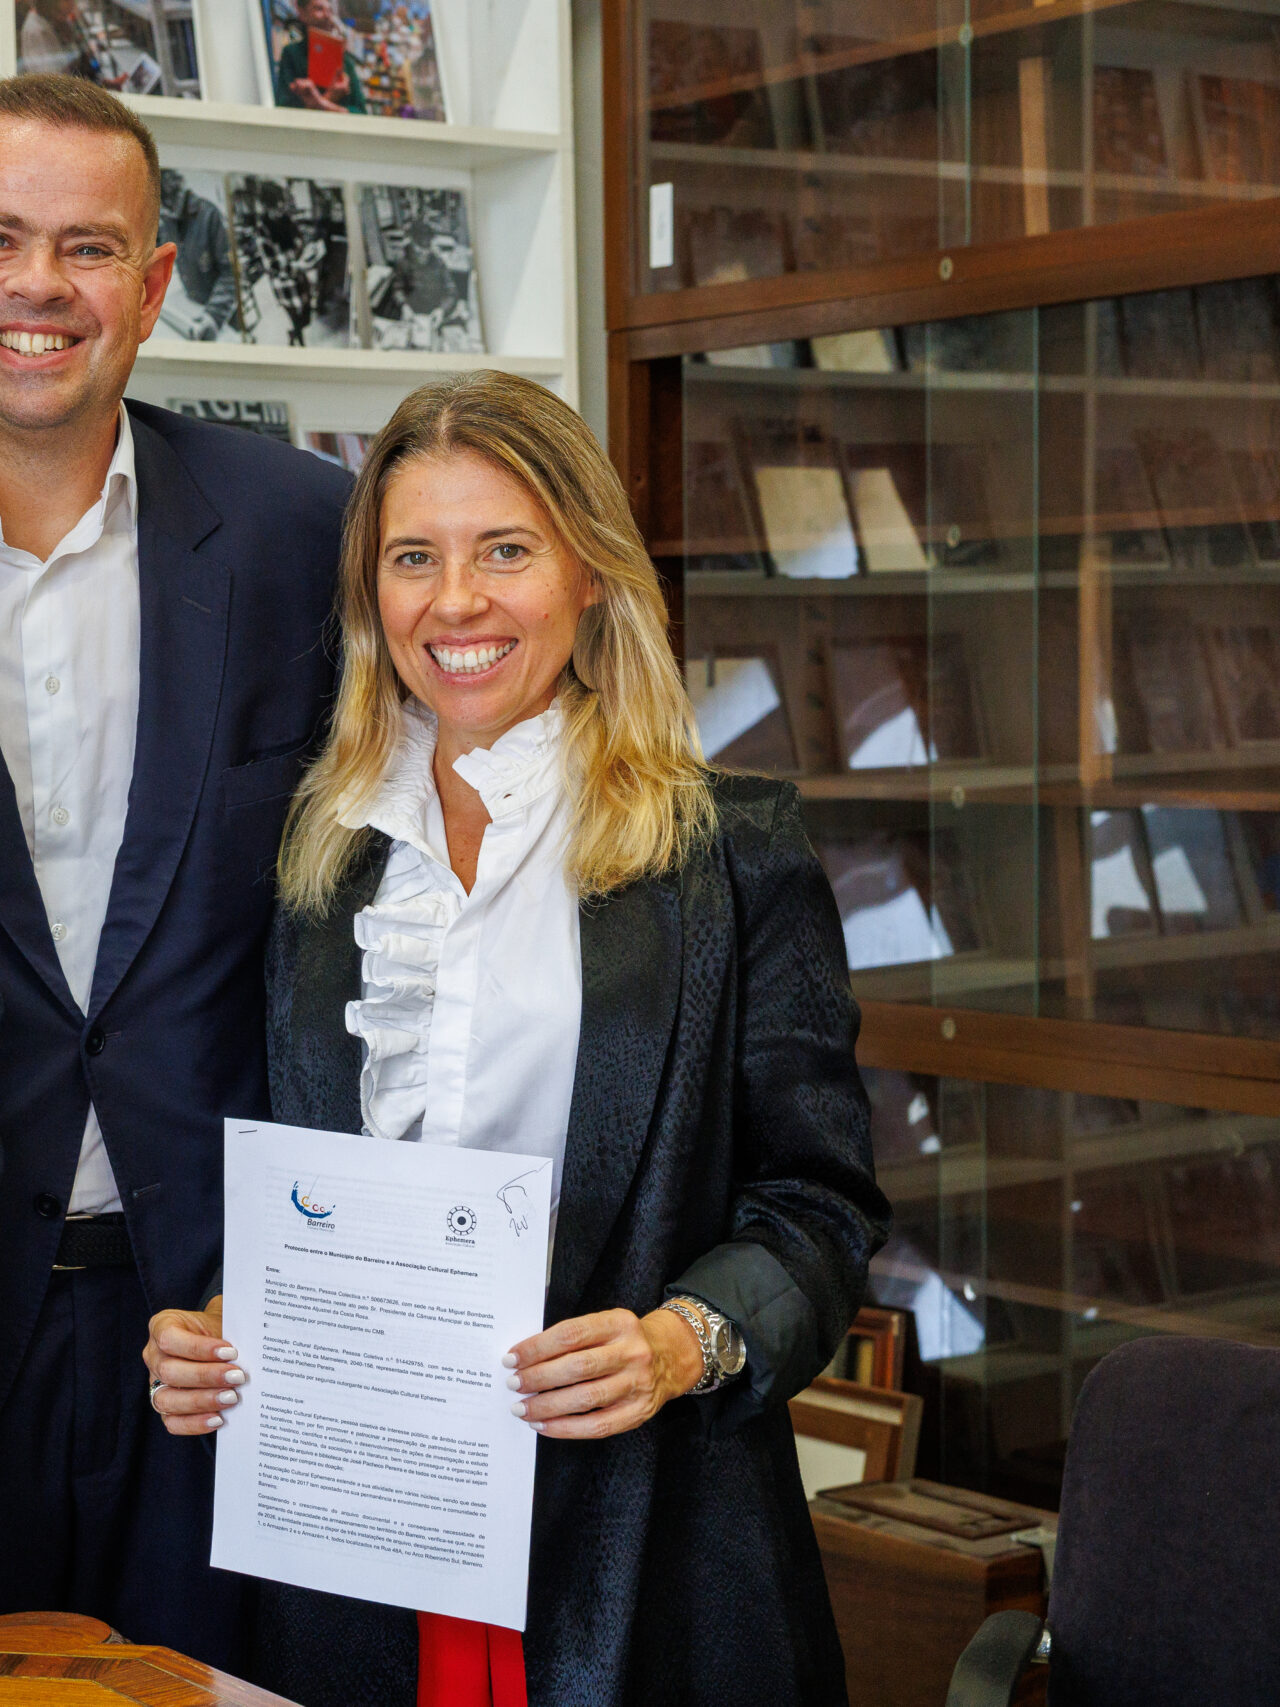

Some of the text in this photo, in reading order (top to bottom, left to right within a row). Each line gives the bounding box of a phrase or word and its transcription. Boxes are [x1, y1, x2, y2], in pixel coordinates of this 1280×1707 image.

[307, 1218, 336, 1229] Barreiro
[445, 1235, 475, 1245] Ephemera
[284, 1244, 309, 1253] Protocolo
[328, 1251, 354, 1261] Município
[363, 1256, 385, 1264] Barreiro
[395, 1261, 426, 1272] Associação
[427, 1265, 449, 1274] Cultural
[450, 1268, 478, 1279] Ephemera
